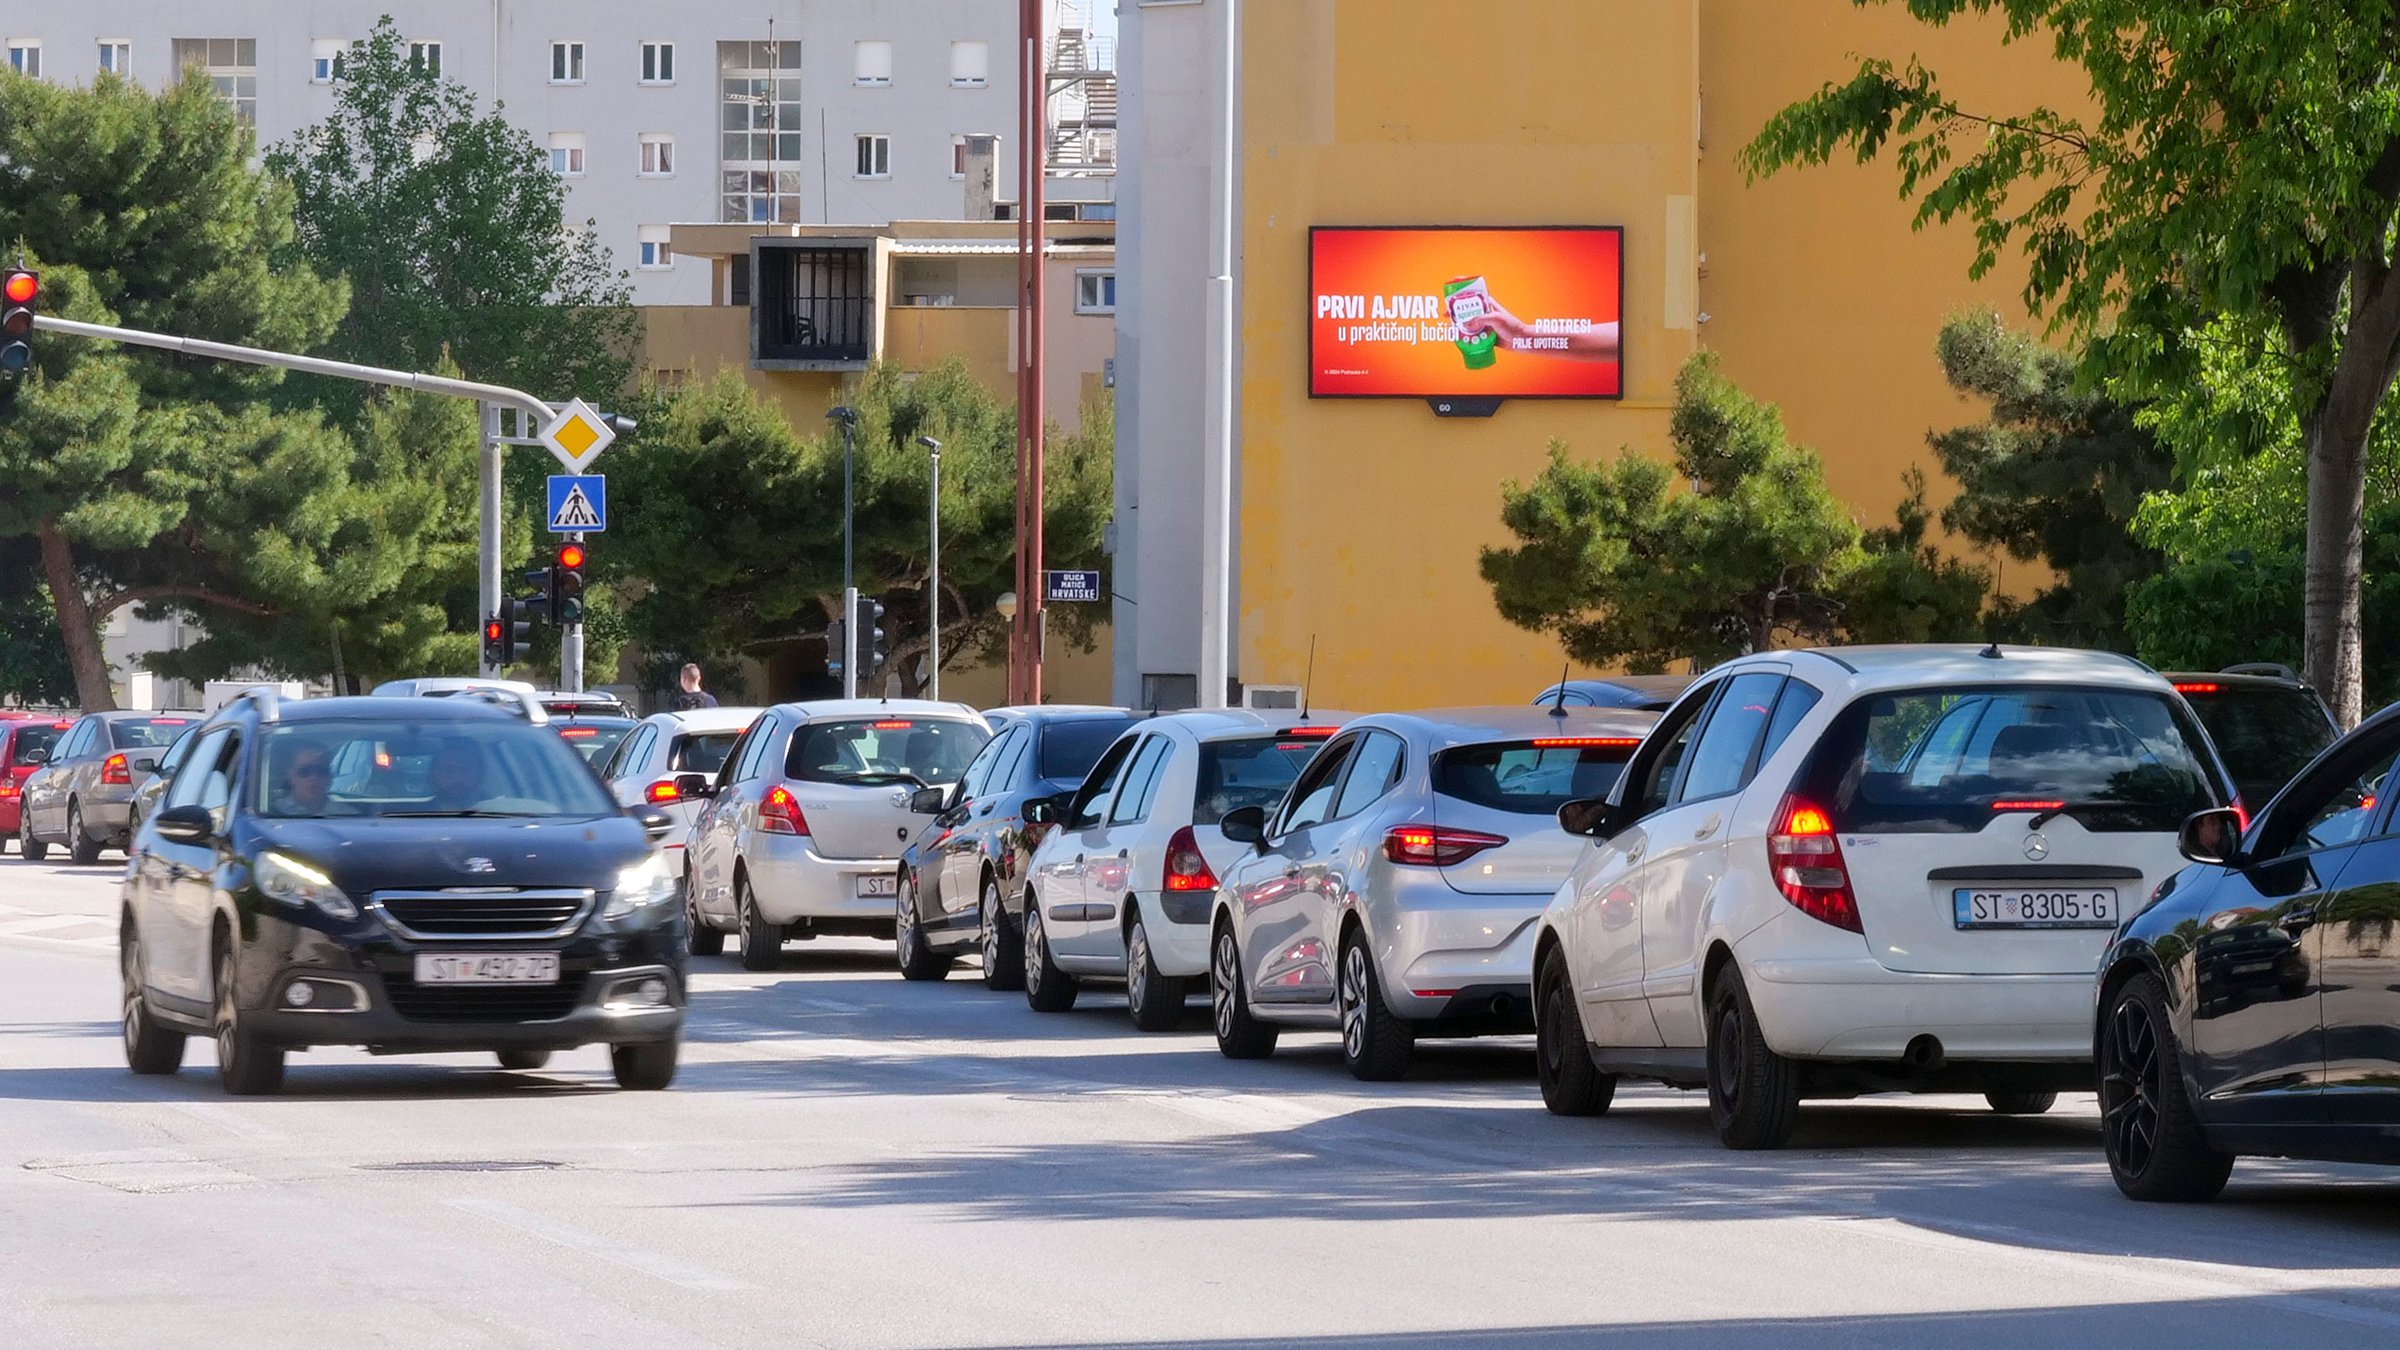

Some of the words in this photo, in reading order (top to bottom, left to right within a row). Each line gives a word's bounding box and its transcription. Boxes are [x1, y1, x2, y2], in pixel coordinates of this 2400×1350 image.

[1317, 295, 1365, 319] PRVI
[1371, 295, 1439, 319] AJVAR
[1338, 326, 1347, 341] u
[1350, 321, 1417, 346] praktičnoj
[1535, 318, 1592, 334] PROTRESI
[1512, 337, 1533, 349] PRIJE
[1533, 337, 1569, 349] UPOTREBE
[1052, 589, 1095, 599] HRVATSKE
[869, 878, 885, 893] ST
[1973, 894, 2002, 919] ST
[2021, 893, 2106, 919] 8305-G
[431, 958, 459, 979] ST
